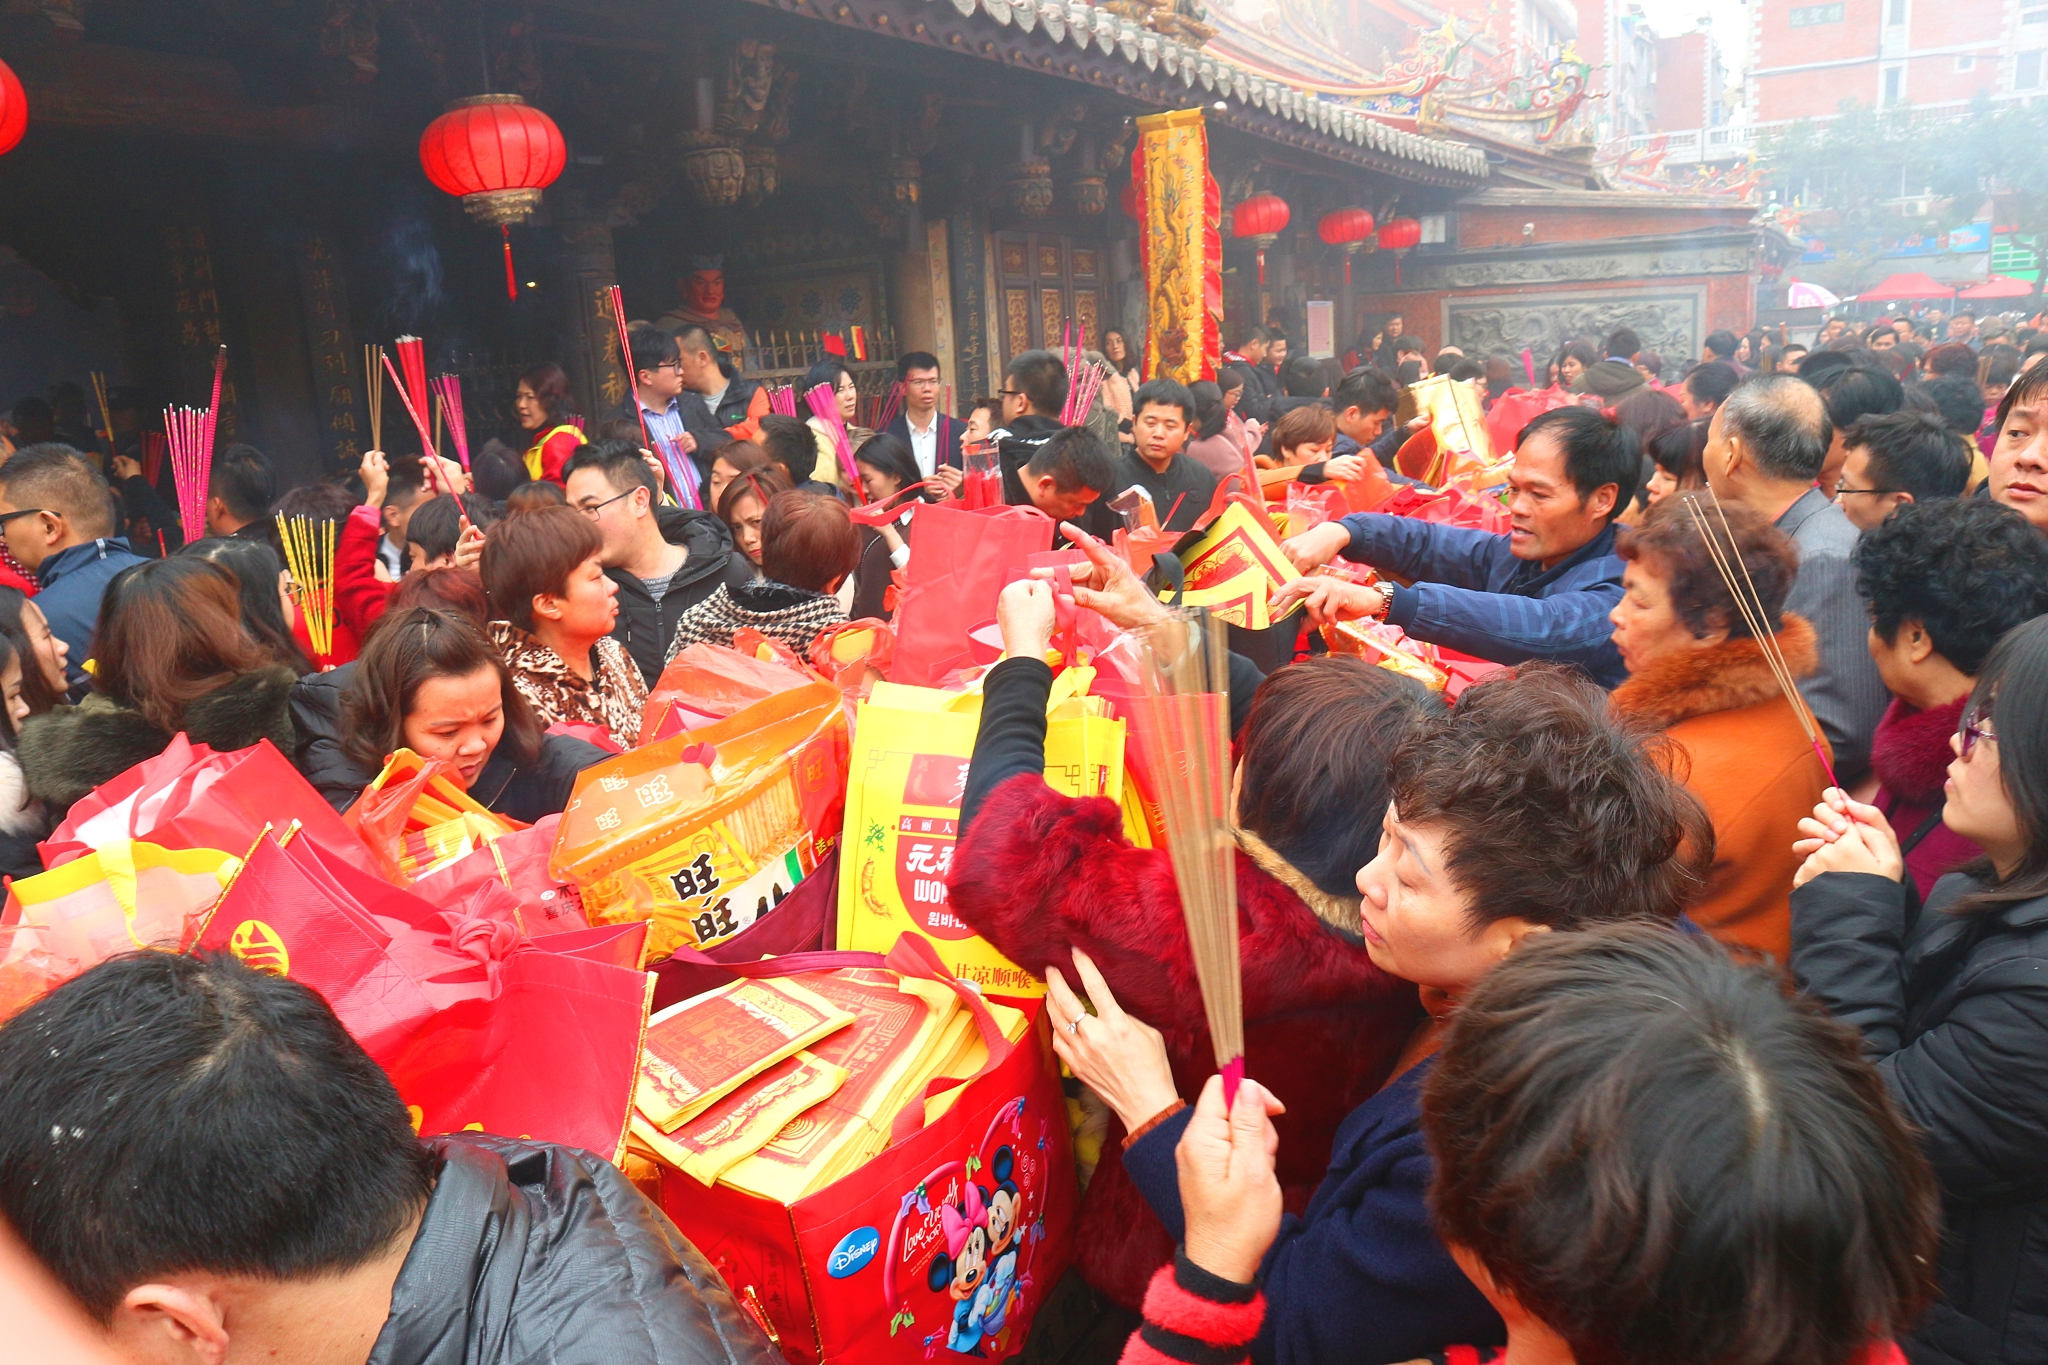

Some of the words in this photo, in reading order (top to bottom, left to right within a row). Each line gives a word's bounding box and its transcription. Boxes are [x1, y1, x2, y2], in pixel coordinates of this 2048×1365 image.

[634, 774, 674, 808] 旺
[594, 806, 622, 831] 旺
[952, 962, 1033, 989] 甘凉顺喉
[834, 1237, 878, 1271] Disney
